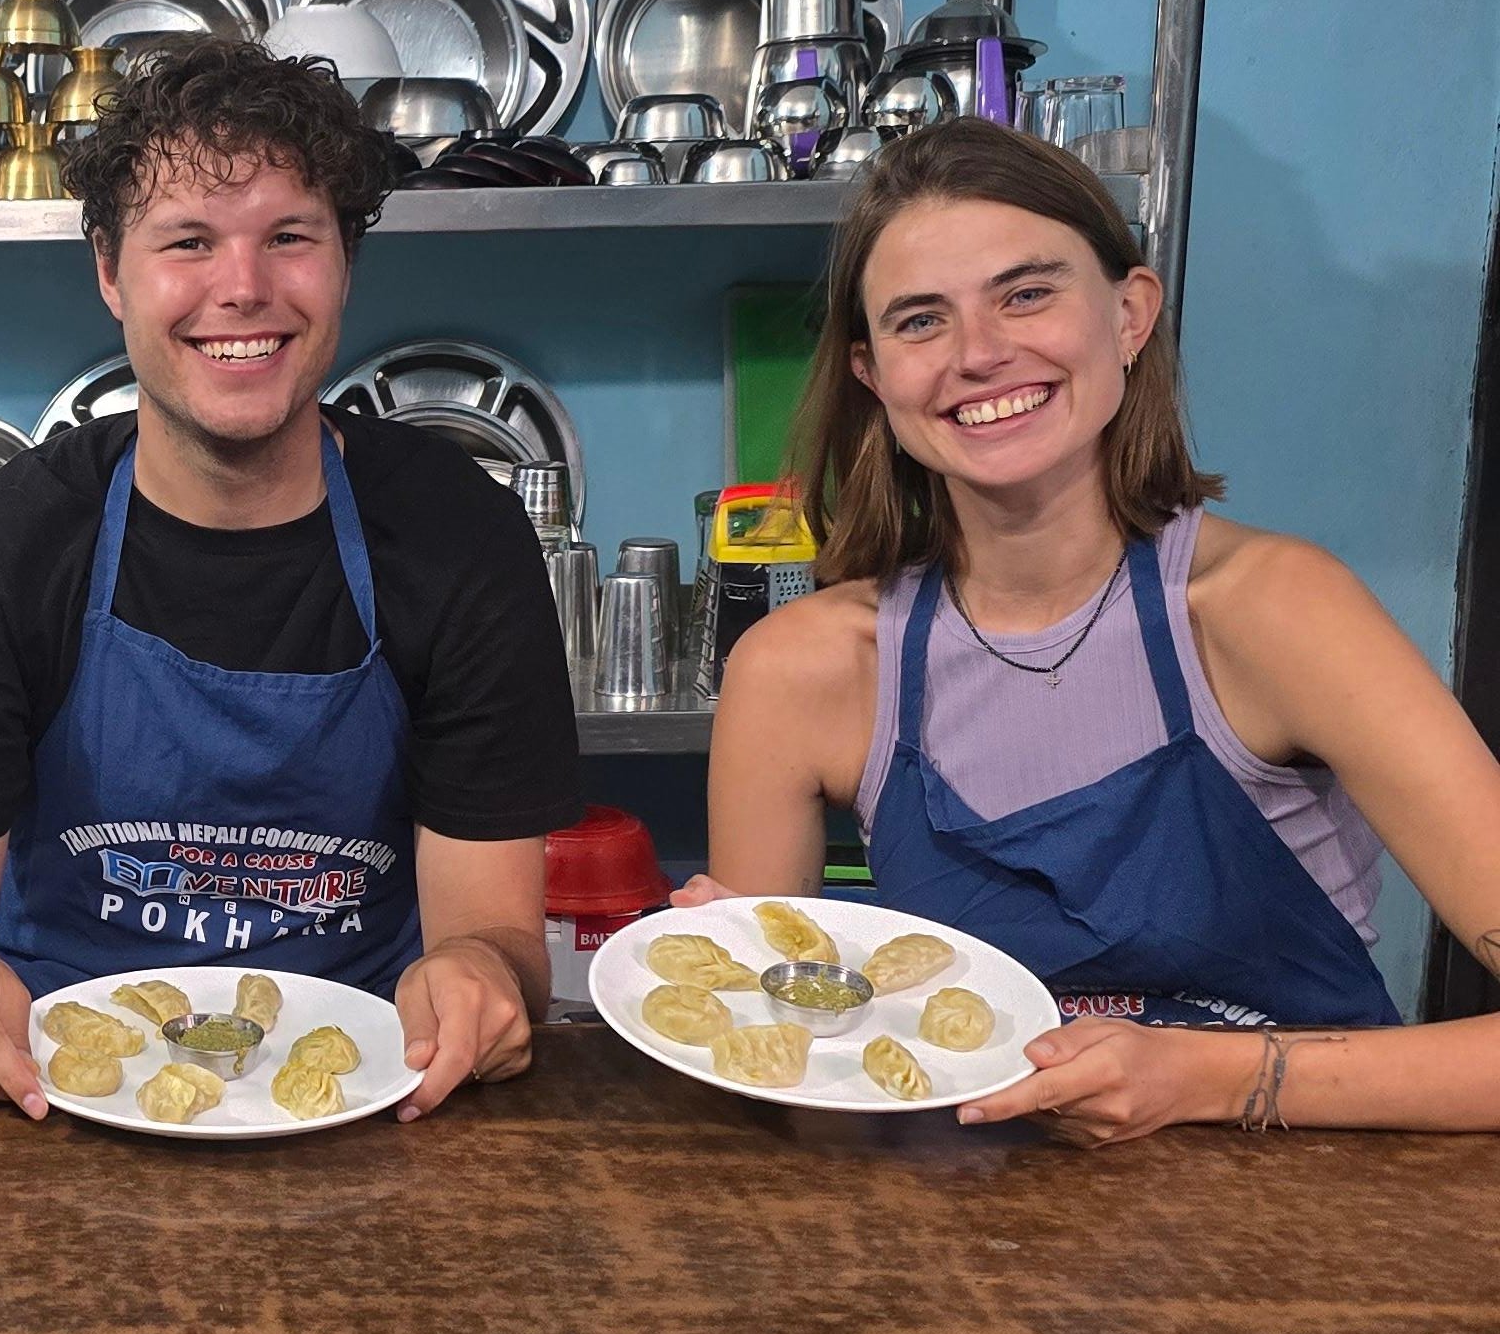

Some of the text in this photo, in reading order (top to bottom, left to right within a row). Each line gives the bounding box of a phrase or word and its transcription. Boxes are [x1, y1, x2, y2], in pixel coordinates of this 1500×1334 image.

[59, 822, 397, 874] TRADITIONAL NEPALI COOKING LESSONS
[169, 843, 318, 871] FOR A CAUSE
[1058, 995, 1145, 1017] CAUSE
